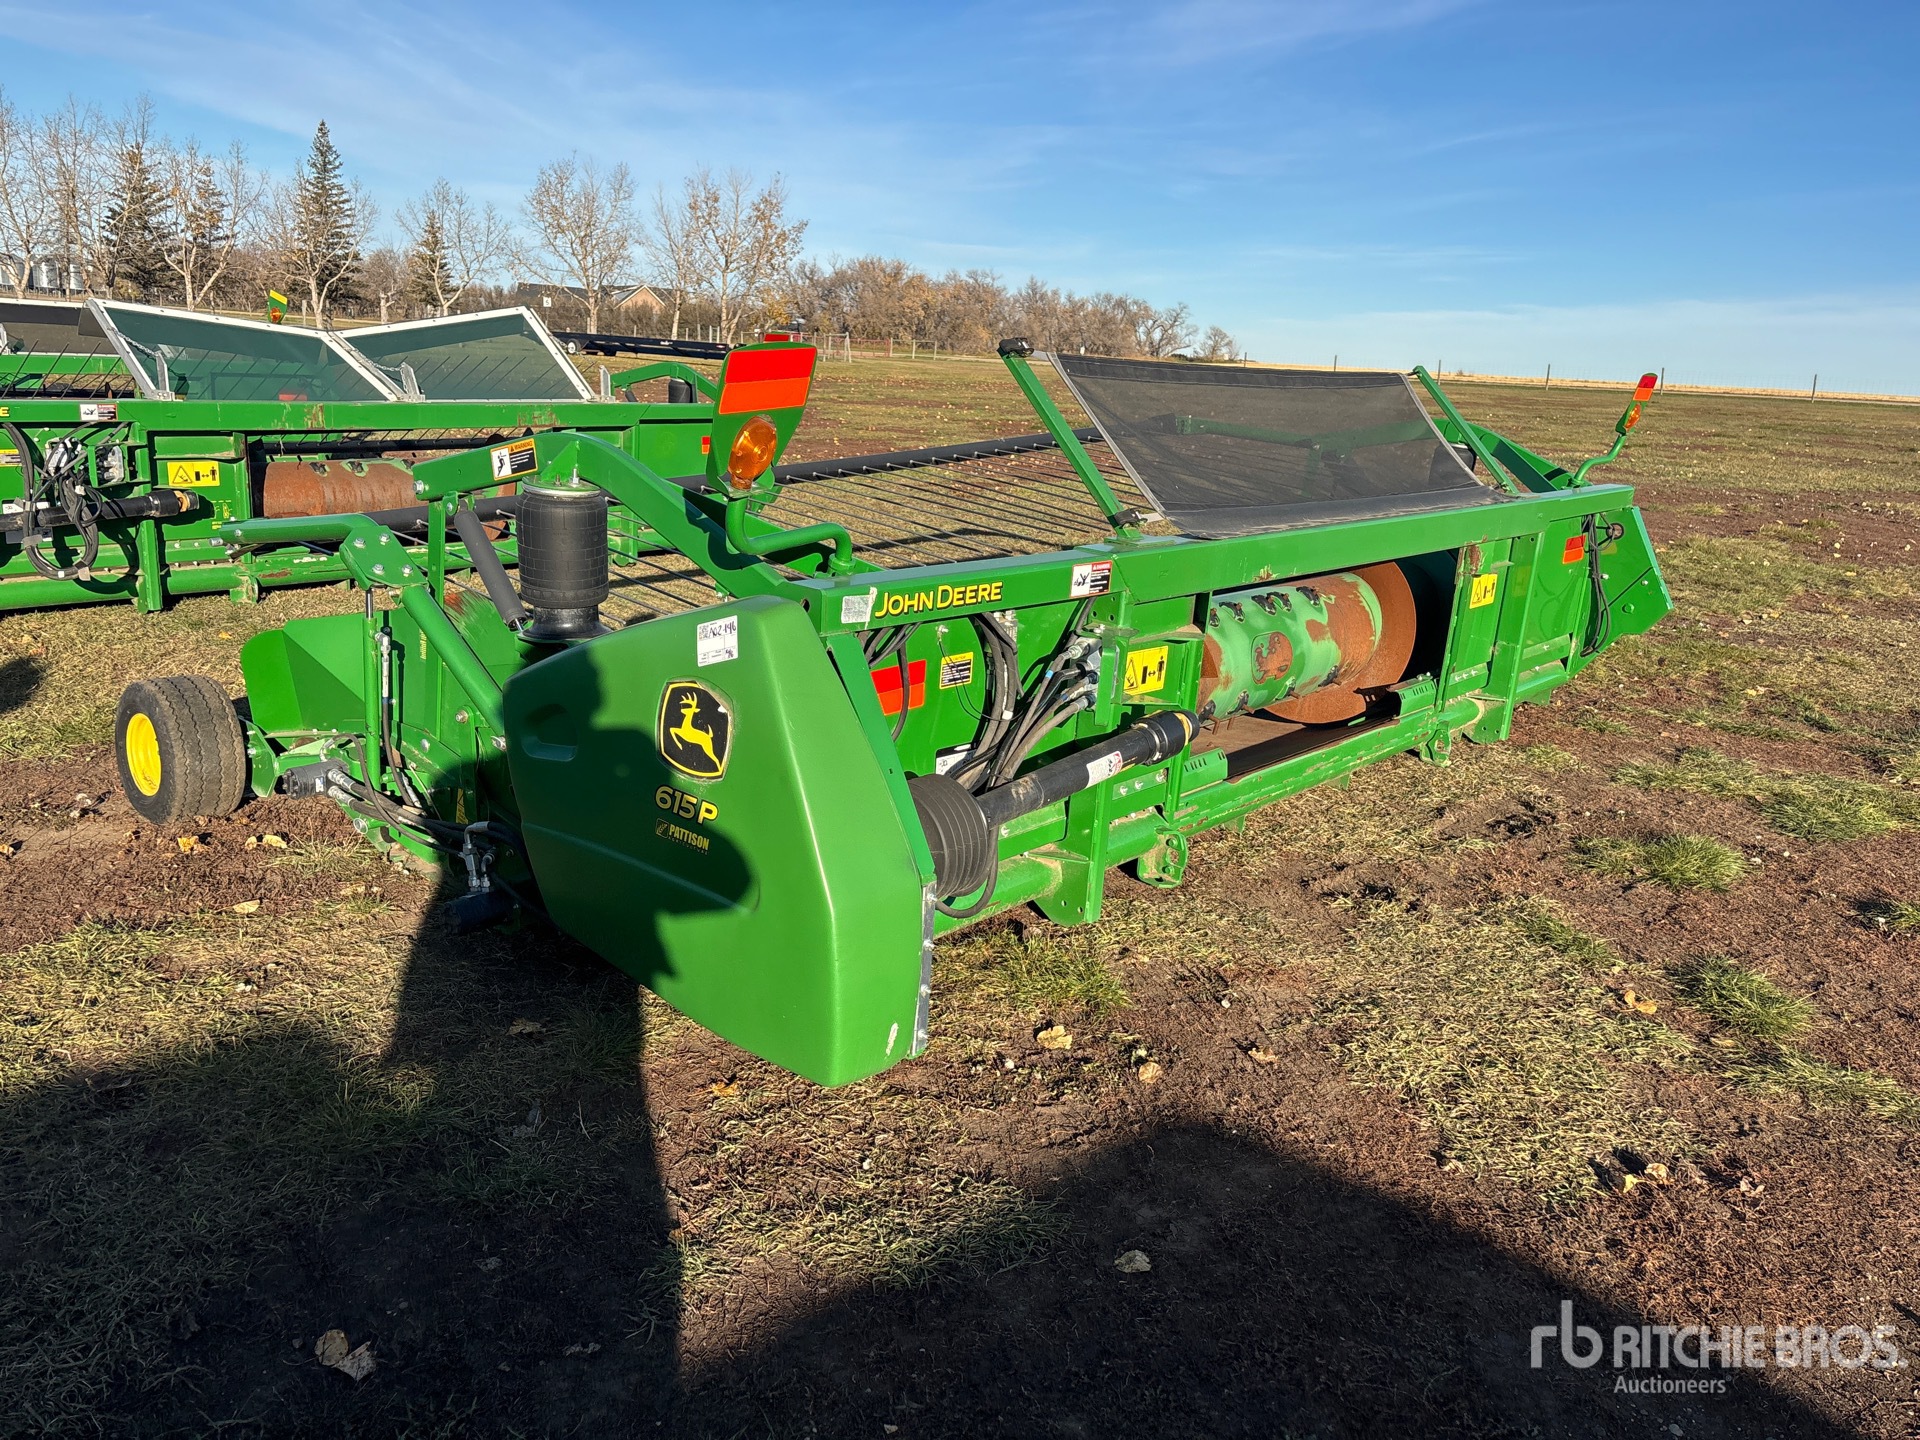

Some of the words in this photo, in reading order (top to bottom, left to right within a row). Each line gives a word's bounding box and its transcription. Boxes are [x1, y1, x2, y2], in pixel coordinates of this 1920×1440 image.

[875, 591, 935, 618] JOHN
[937, 582, 1003, 609] DEERE
[654, 784, 719, 825] 615P
[668, 823, 710, 851] PATTISON
